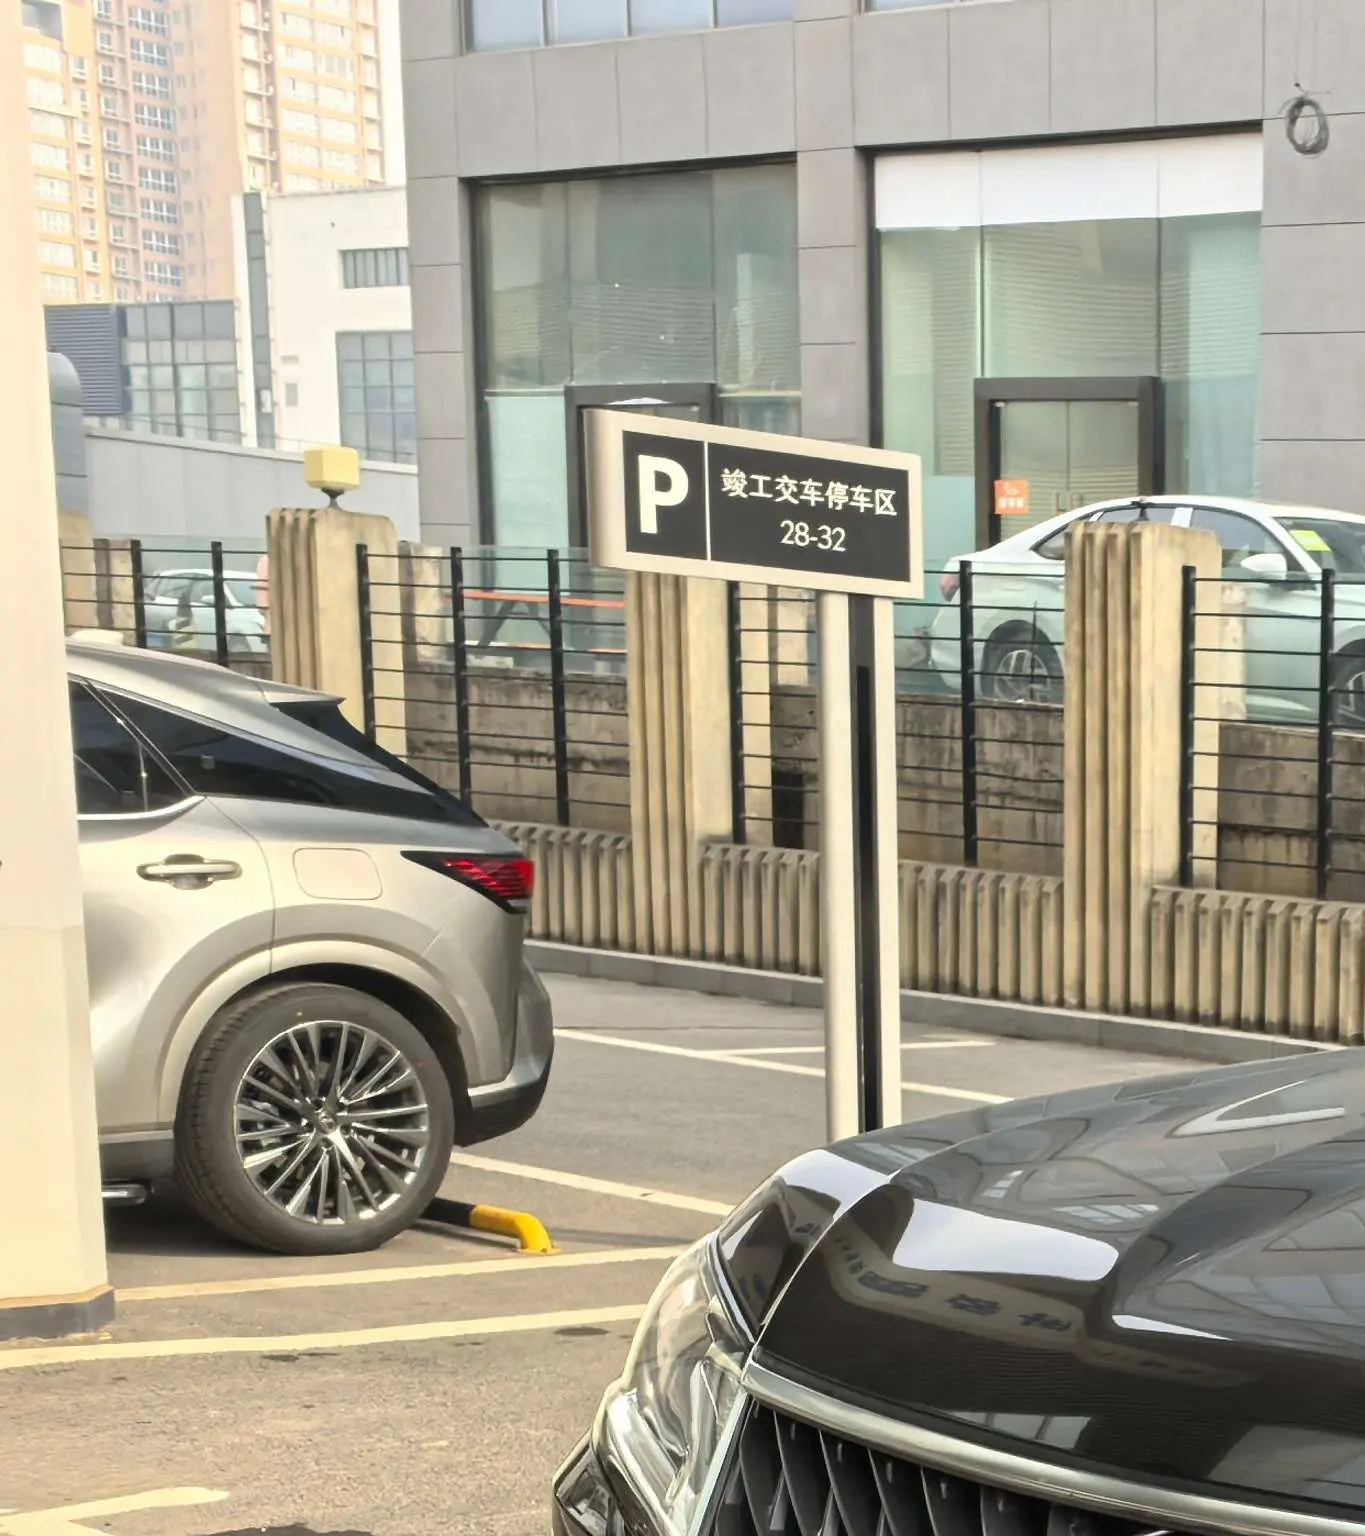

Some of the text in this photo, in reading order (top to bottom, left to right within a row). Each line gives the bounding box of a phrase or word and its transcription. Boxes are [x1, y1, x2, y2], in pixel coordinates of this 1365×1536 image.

[637, 454, 689, 534] P
[720, 468, 898, 516] 竣工交车停车区
[780, 520, 846, 552] 28-32
